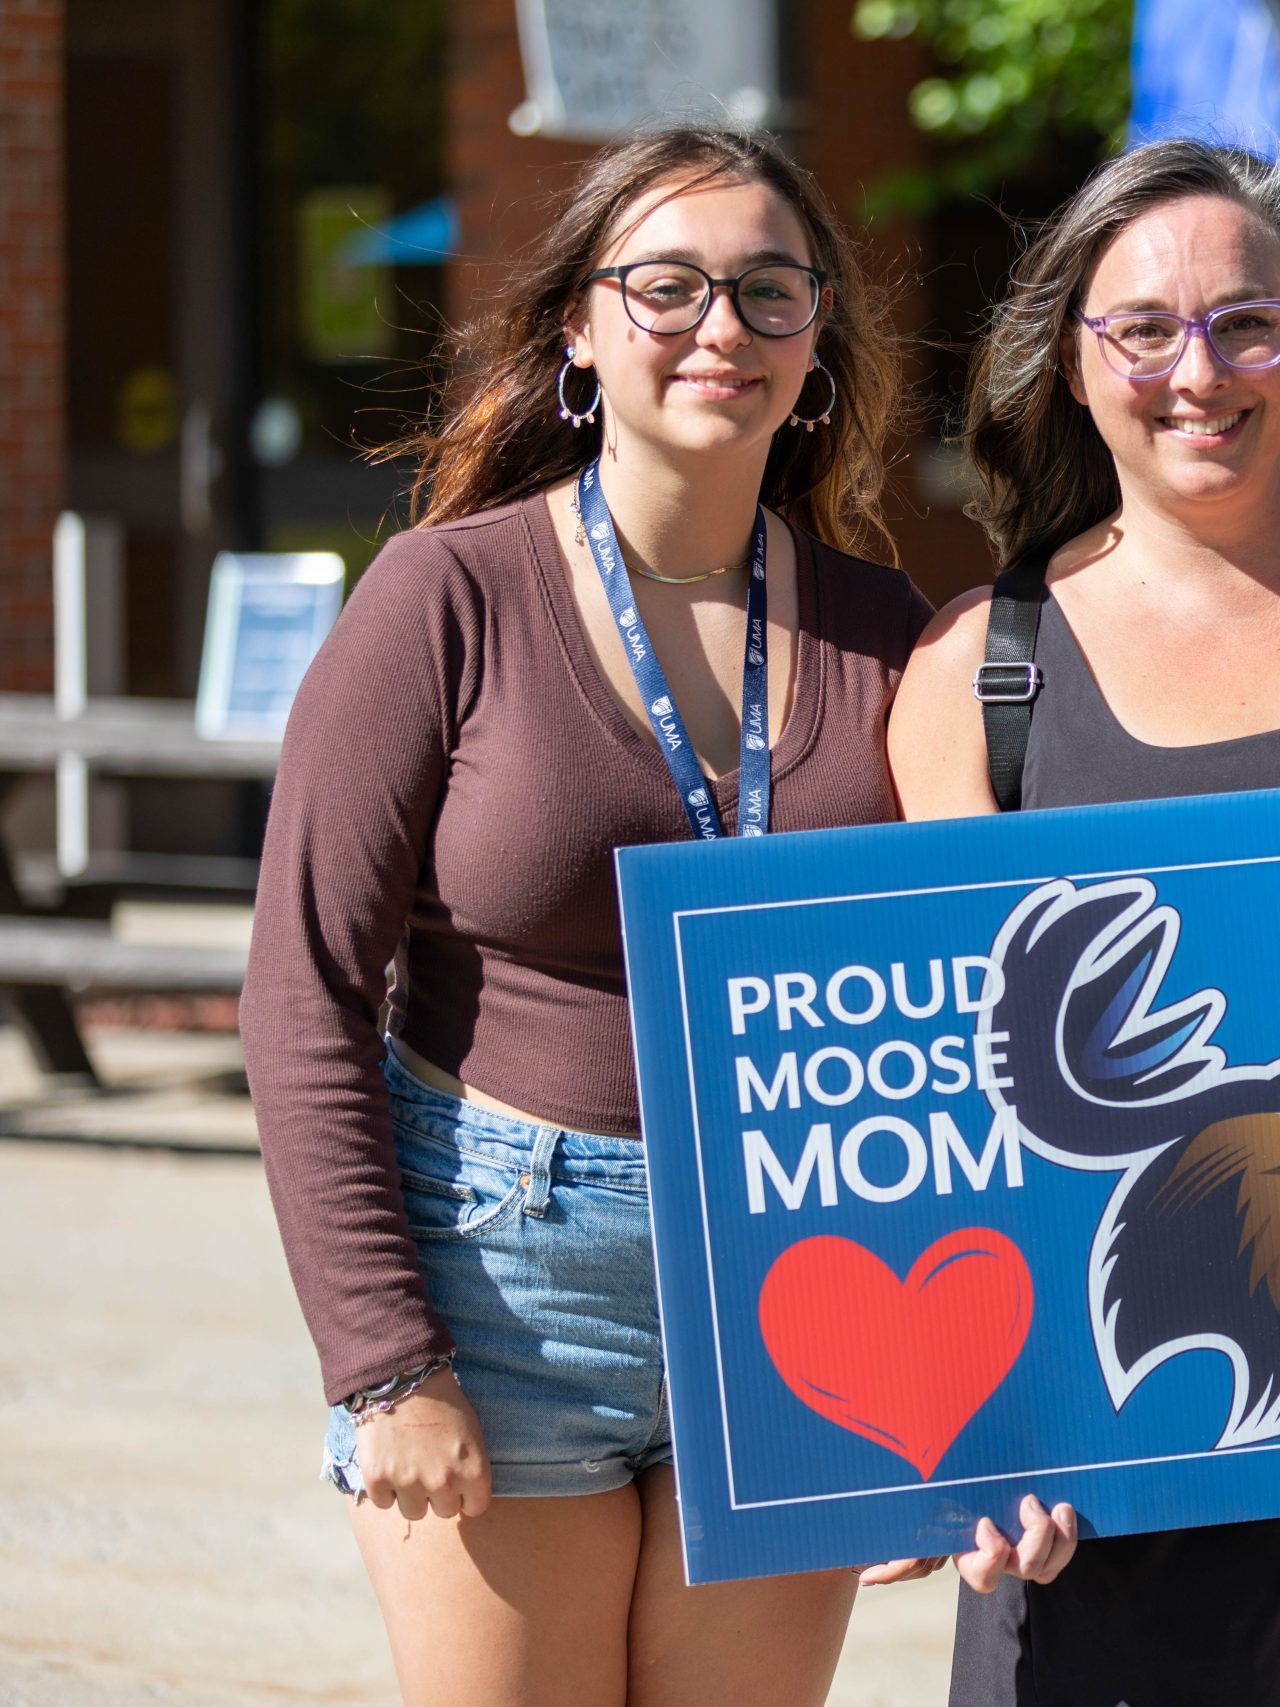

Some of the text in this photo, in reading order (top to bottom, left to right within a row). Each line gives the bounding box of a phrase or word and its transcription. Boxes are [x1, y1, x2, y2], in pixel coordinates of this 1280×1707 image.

[597, 539, 616, 574] UMA
[626, 625, 646, 663] UMA
[751, 619, 762, 649] UMA
[660, 714, 682, 751] UMA
[749, 703, 761, 734] UMA
[749, 788, 762, 823] UMA
[727, 955, 1006, 1035] PROUD
[735, 1031, 1014, 1114] MOOSE
[742, 1105, 1024, 1215] MOM
